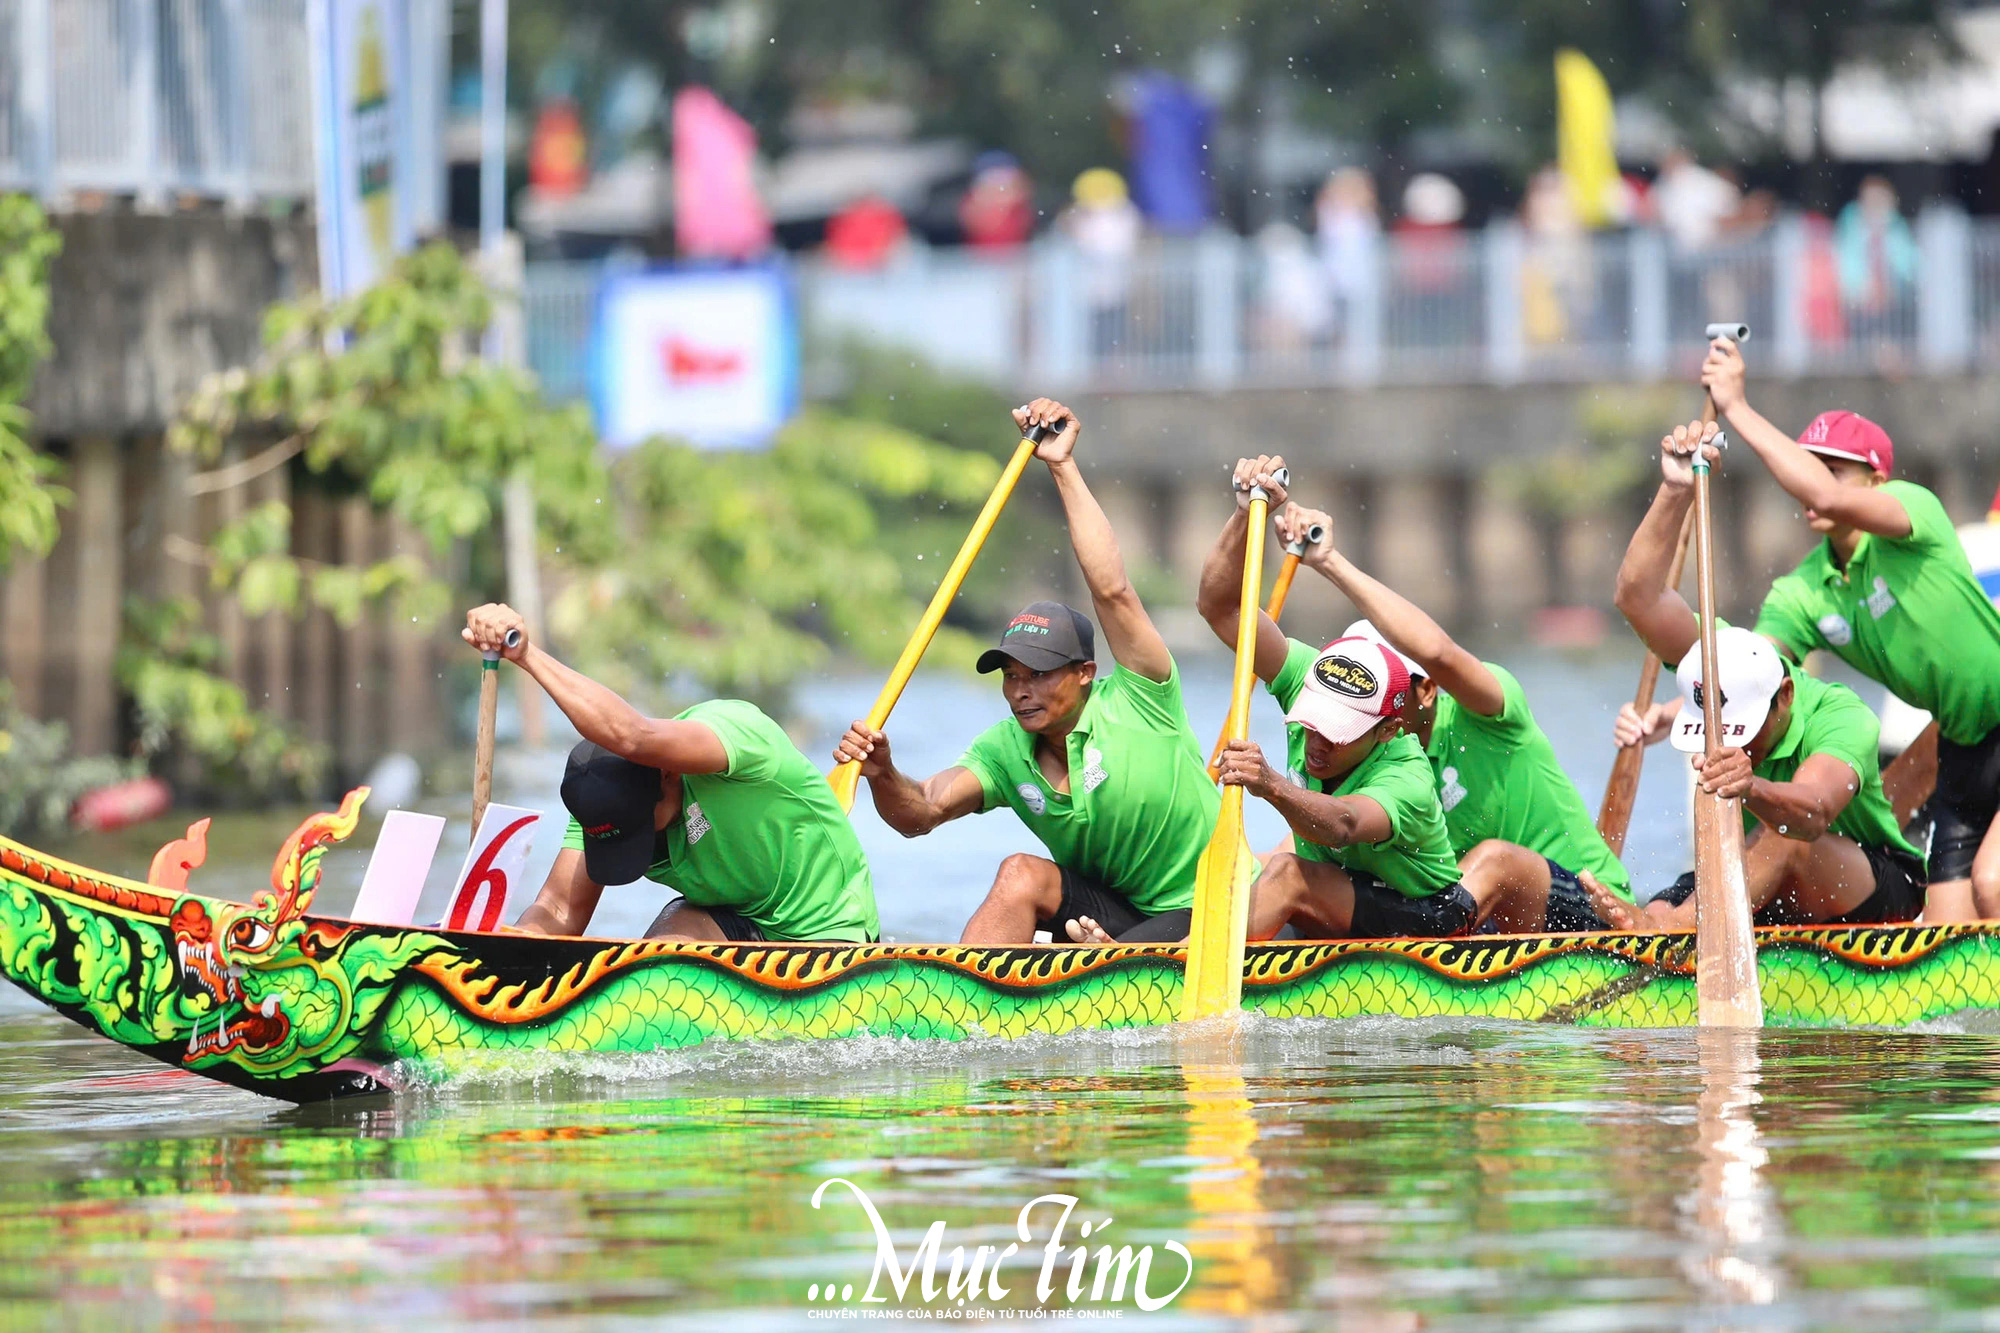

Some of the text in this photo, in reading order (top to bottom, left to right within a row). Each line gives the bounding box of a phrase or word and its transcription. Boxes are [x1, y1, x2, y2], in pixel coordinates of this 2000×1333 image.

[1319, 659, 1375, 690] Super Fast
[448, 815, 540, 932] 6
